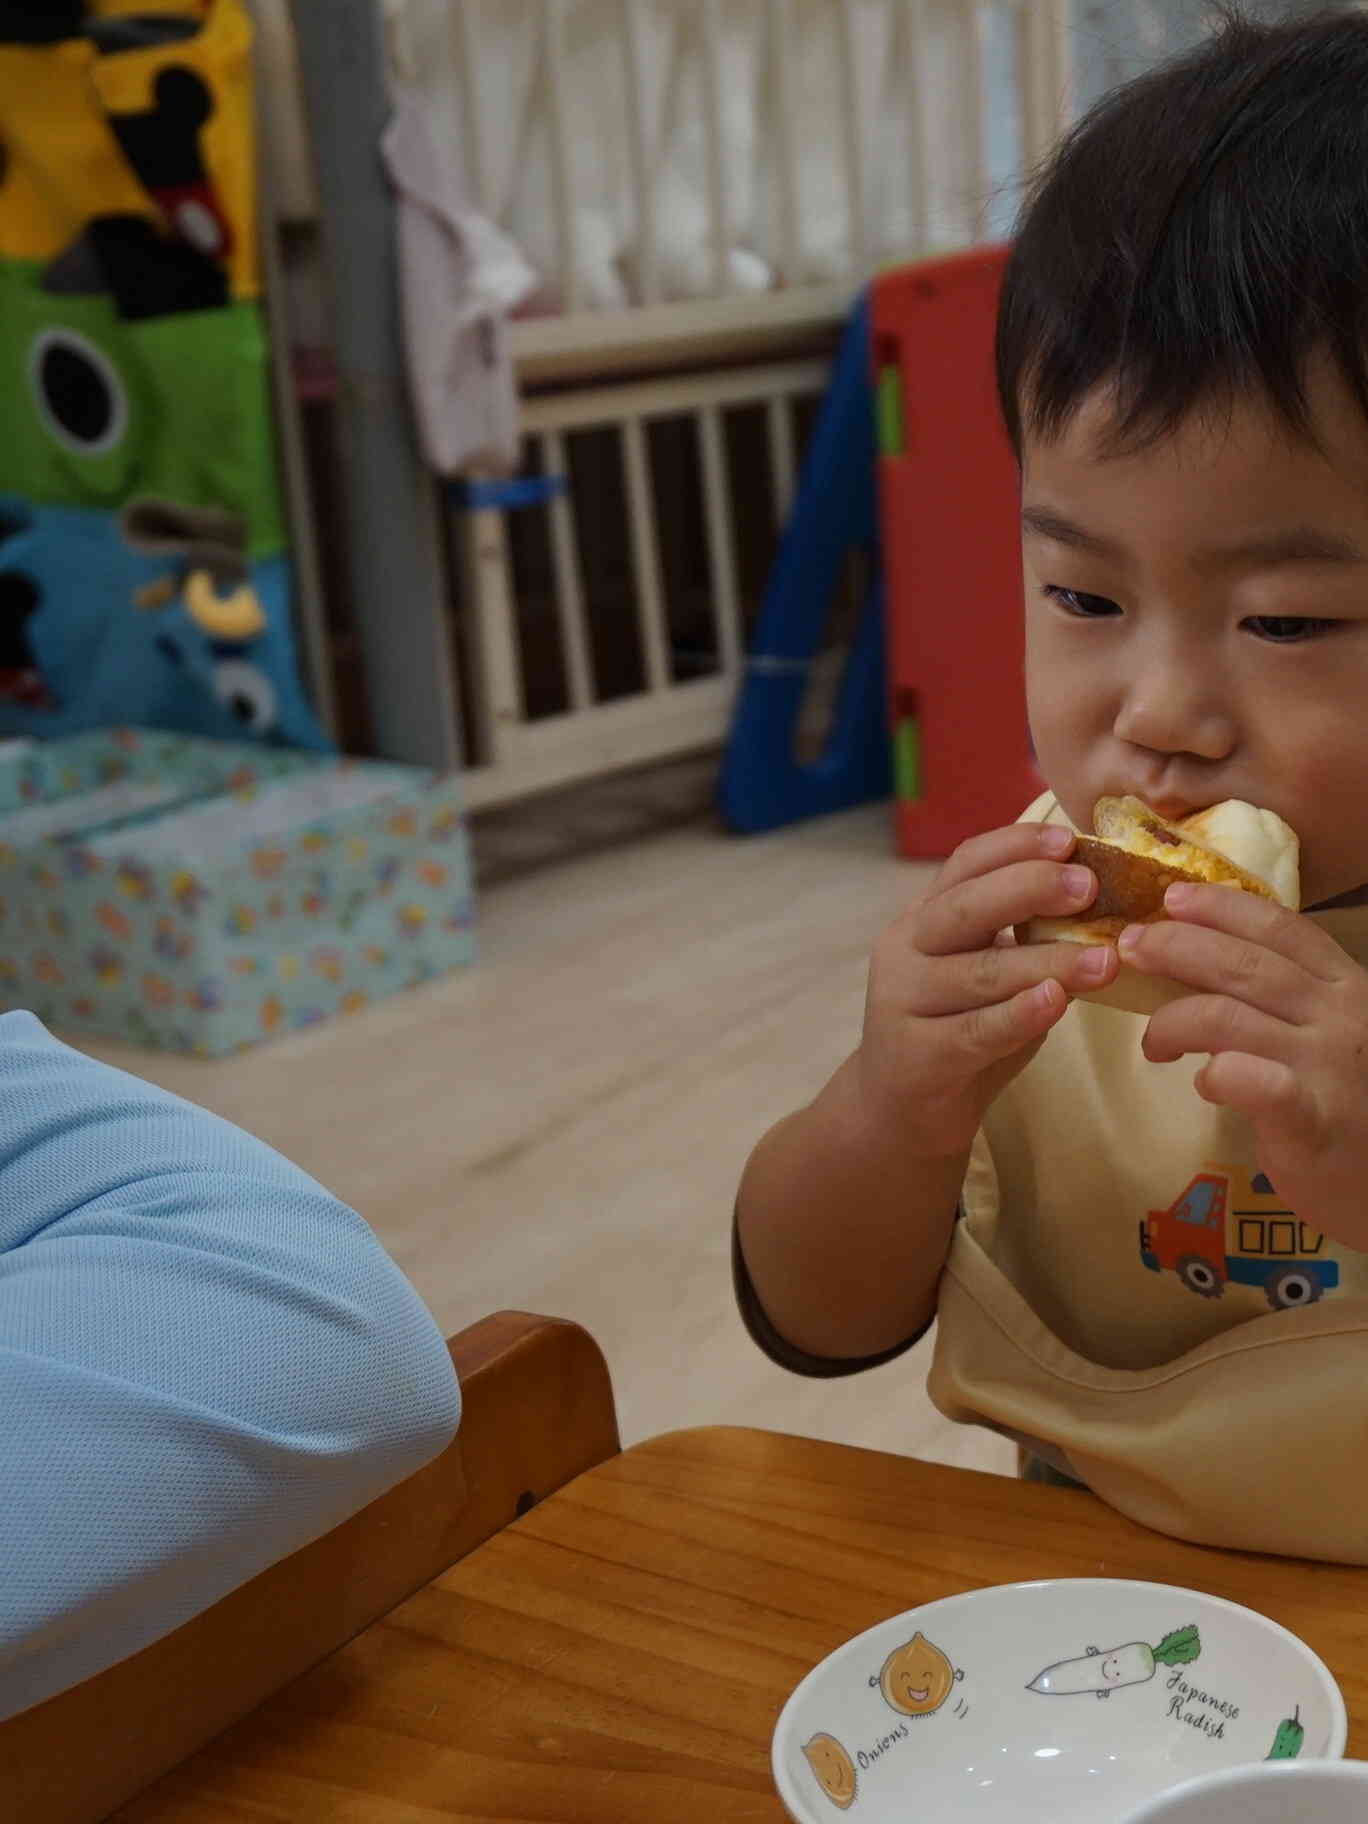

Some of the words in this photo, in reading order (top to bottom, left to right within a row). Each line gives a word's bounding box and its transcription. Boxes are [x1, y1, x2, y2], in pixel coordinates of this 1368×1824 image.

[1166, 1670, 1240, 1719] Japanese
[1166, 1695, 1225, 1739] Radish
[856, 1722, 909, 1770] Onions
